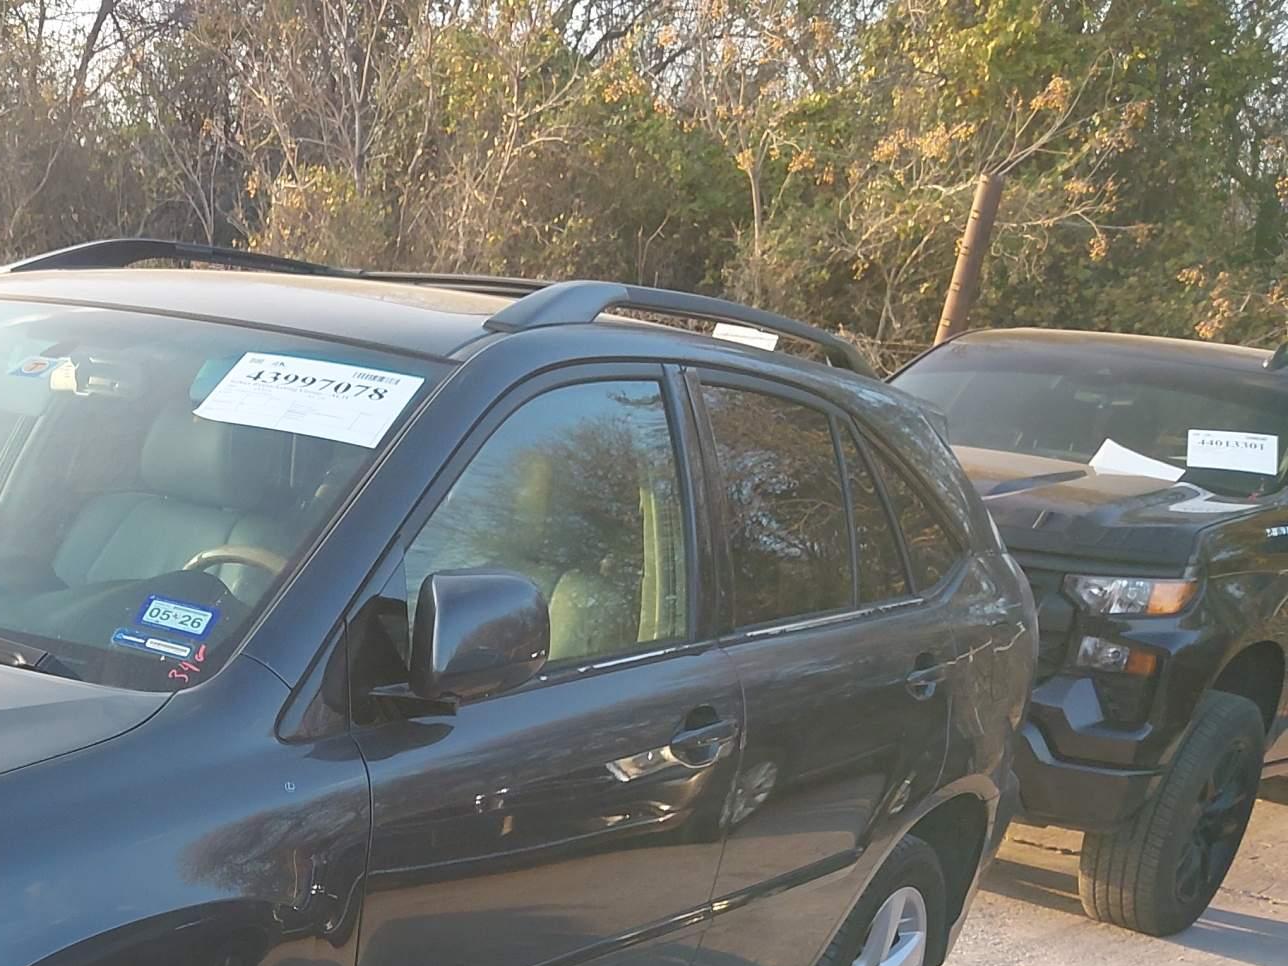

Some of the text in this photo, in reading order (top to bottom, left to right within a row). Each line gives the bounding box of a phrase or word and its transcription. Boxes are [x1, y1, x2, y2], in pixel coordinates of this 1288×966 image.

[245, 368, 389, 401] 43997078
[148, 607, 172, 621] 05
[178, 614, 203, 629] 26
